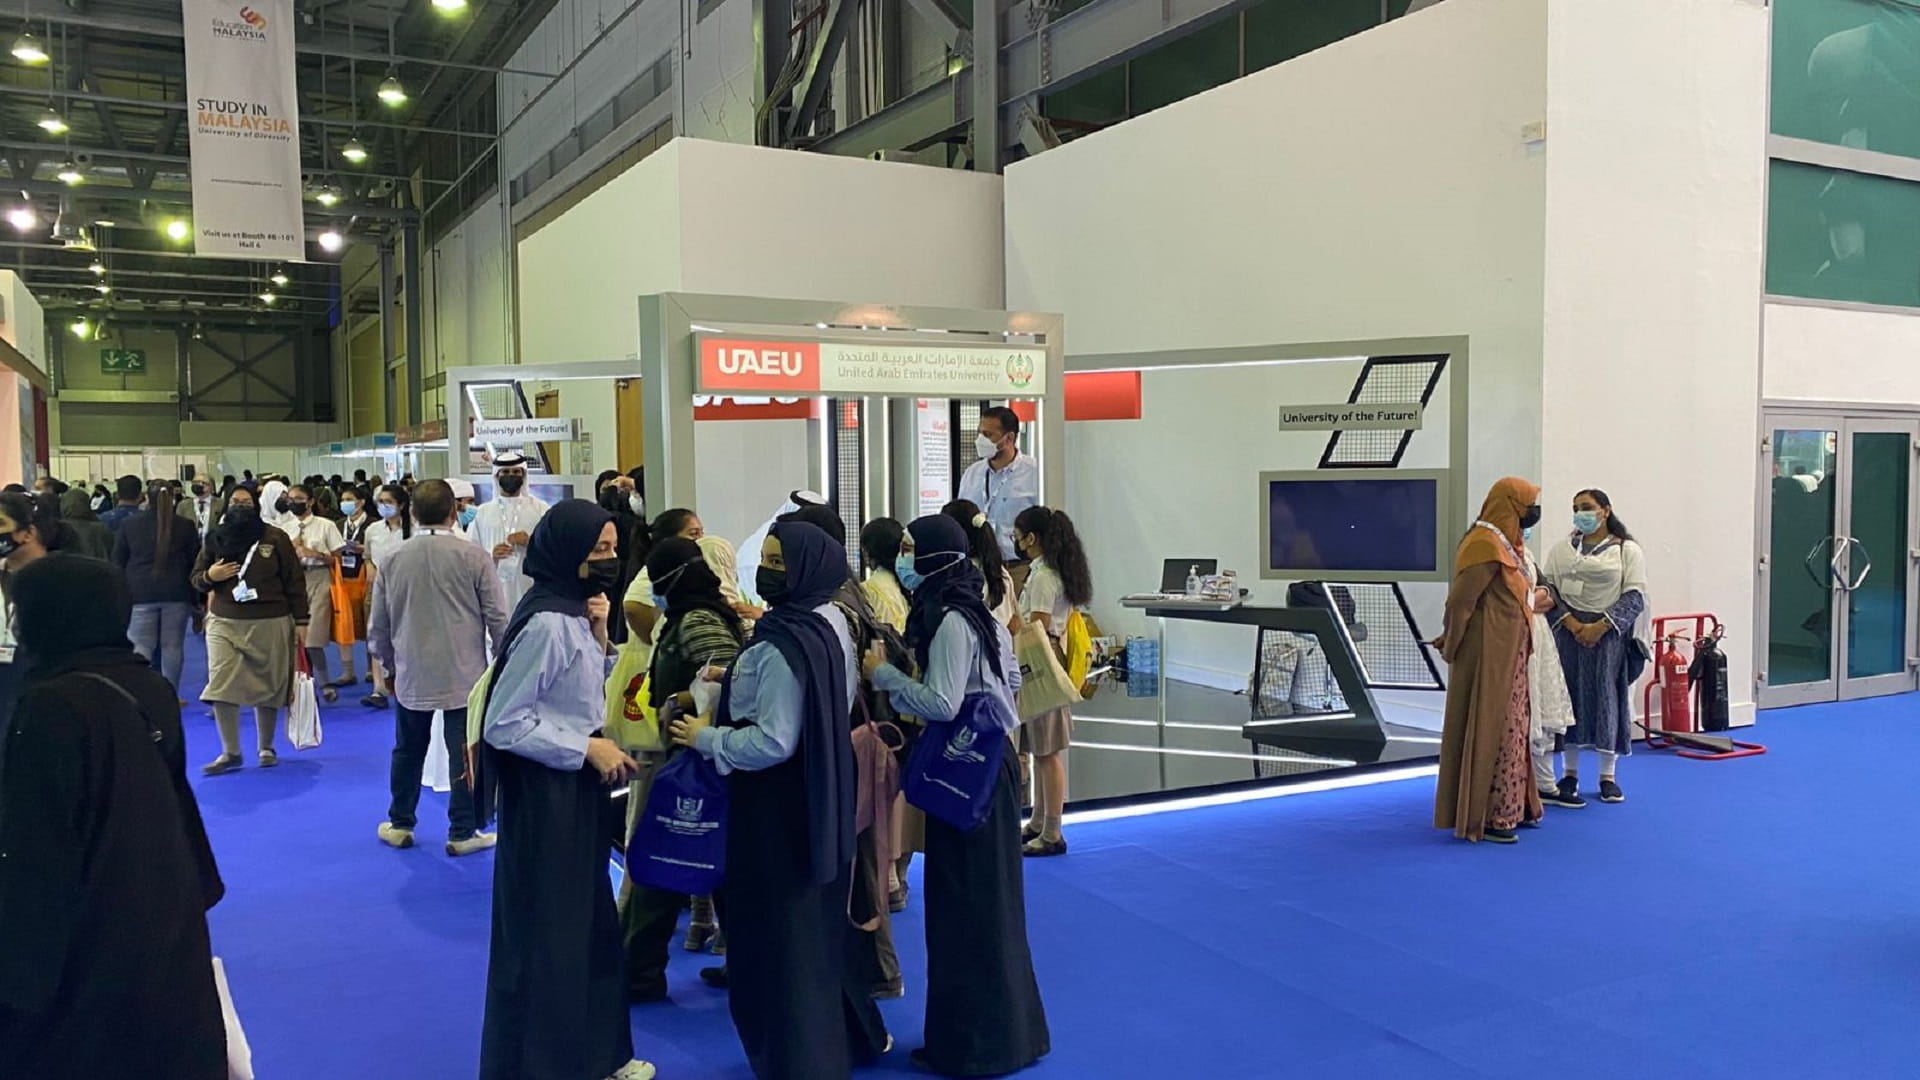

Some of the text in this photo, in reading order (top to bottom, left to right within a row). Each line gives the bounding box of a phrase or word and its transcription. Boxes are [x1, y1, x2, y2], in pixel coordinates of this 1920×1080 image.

[212, 27, 266, 40] MALAYSIA
[197, 99, 268, 116] STUDY IN
[198, 112, 291, 133] MALAYSIA
[198, 127, 241, 138] University
[253, 132, 291, 143] Diversity
[202, 229, 221, 238] Visit
[241, 231, 266, 240] Booth
[239, 241, 255, 249] Hall
[717, 348, 803, 377] UAEU
[837, 351, 1000, 368] جامعة الإمارات العربية المتحدة
[838, 367, 1000, 384] United Arab Emirates University
[1283, 410, 1417, 424] University of the Future!
[476, 424, 568, 436] University of the Future!
